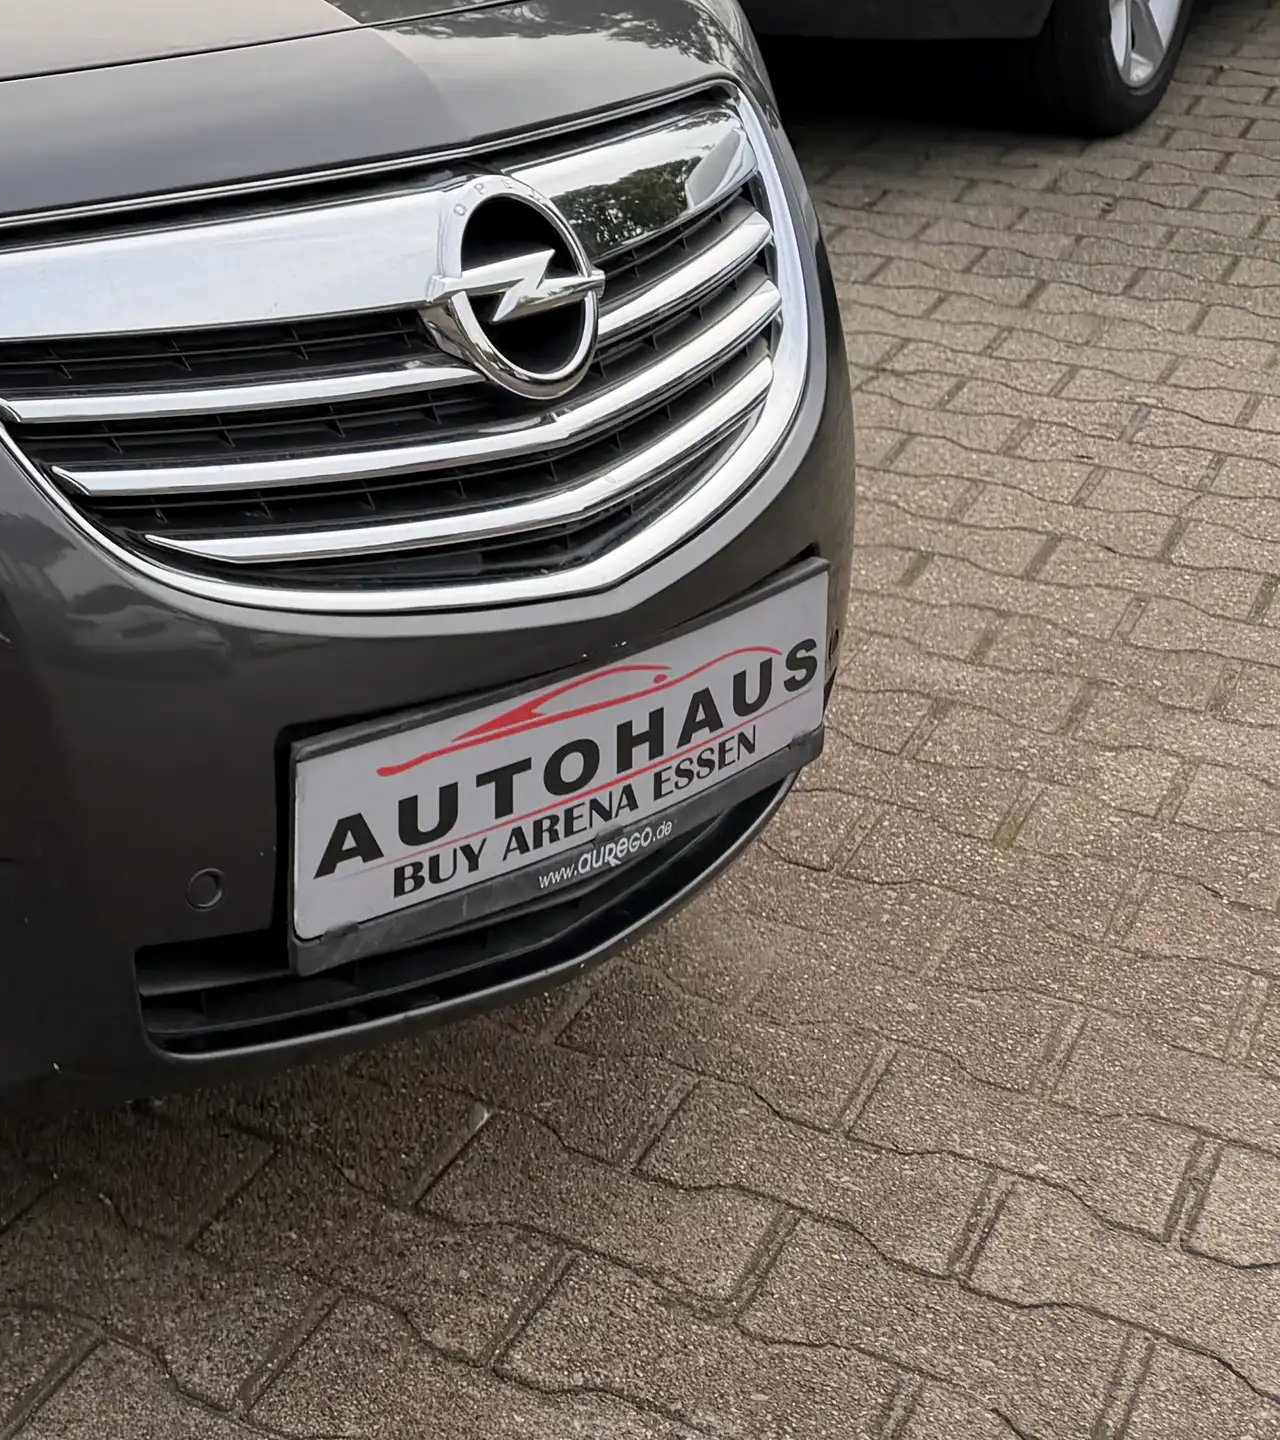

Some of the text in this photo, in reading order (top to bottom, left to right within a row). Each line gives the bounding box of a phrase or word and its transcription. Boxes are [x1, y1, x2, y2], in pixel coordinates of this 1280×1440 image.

[314, 638, 819, 879] AUTOHAUS
[393, 725, 758, 898] BUY ARENA ESSEN
